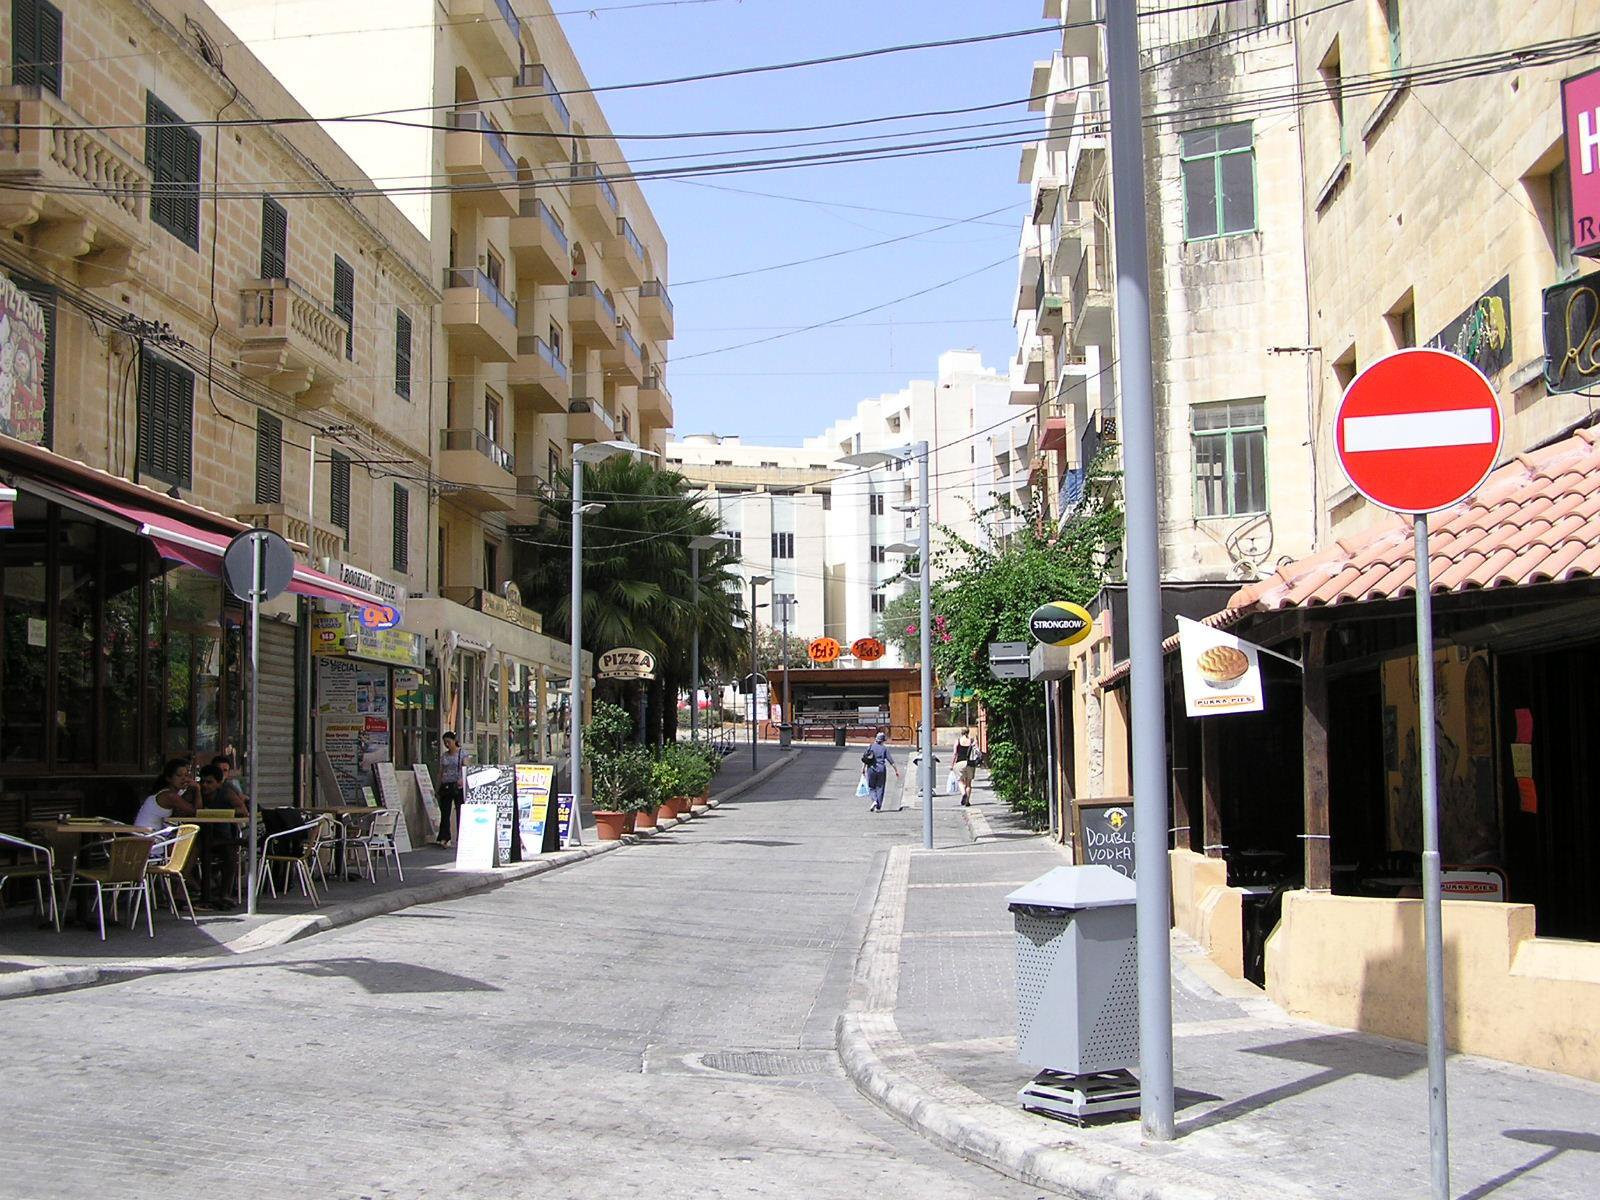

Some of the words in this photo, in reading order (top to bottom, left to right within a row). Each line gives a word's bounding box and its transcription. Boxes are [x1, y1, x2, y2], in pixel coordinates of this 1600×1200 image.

[343, 568, 372, 591] BOOKING
[375, 580, 396, 600] OFFICE
[1033, 621, 1082, 629] STRONGBOW
[603, 653, 650, 668] PIZZA
[1088, 847, 1132, 861] VODKA
